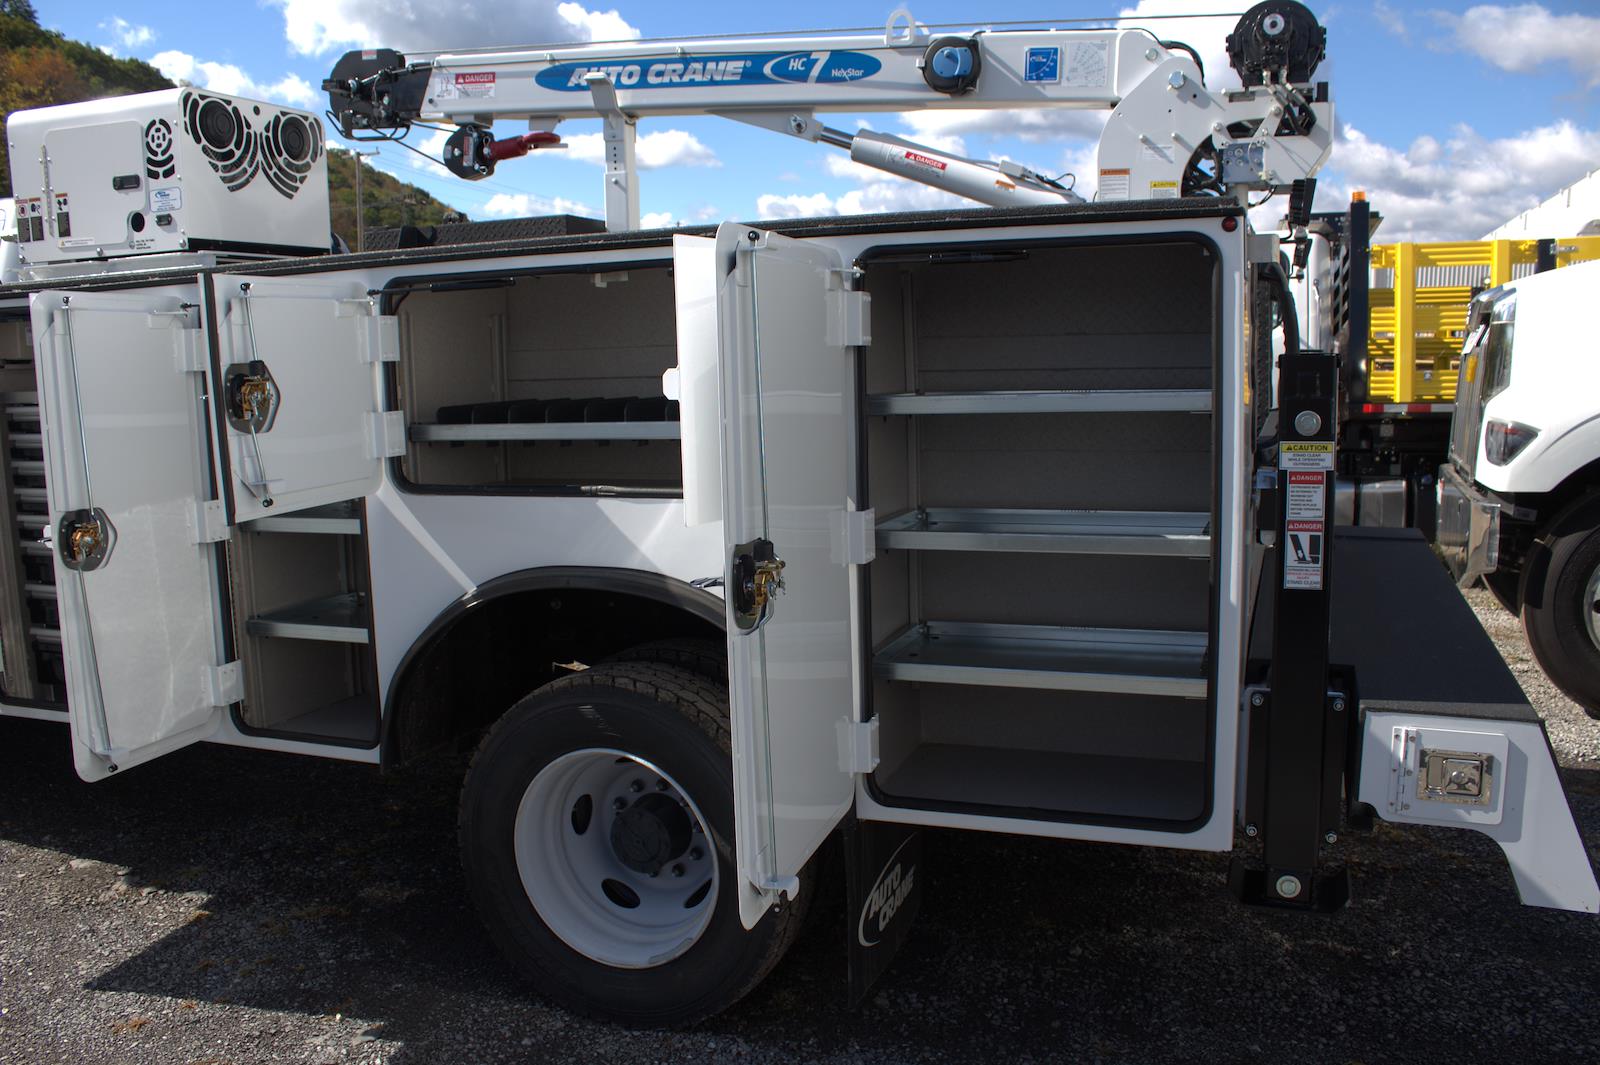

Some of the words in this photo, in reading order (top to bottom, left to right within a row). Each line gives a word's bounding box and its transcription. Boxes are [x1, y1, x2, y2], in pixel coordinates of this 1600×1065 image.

[465, 74, 494, 83] DANGER
[567, 65, 641, 87] ATO
[788, 58, 807, 71] HC
[807, 51, 832, 84] 7
[915, 154, 943, 168] DANGER
[868, 863, 901, 920] AUTO
[879, 864, 916, 931] CRANE
